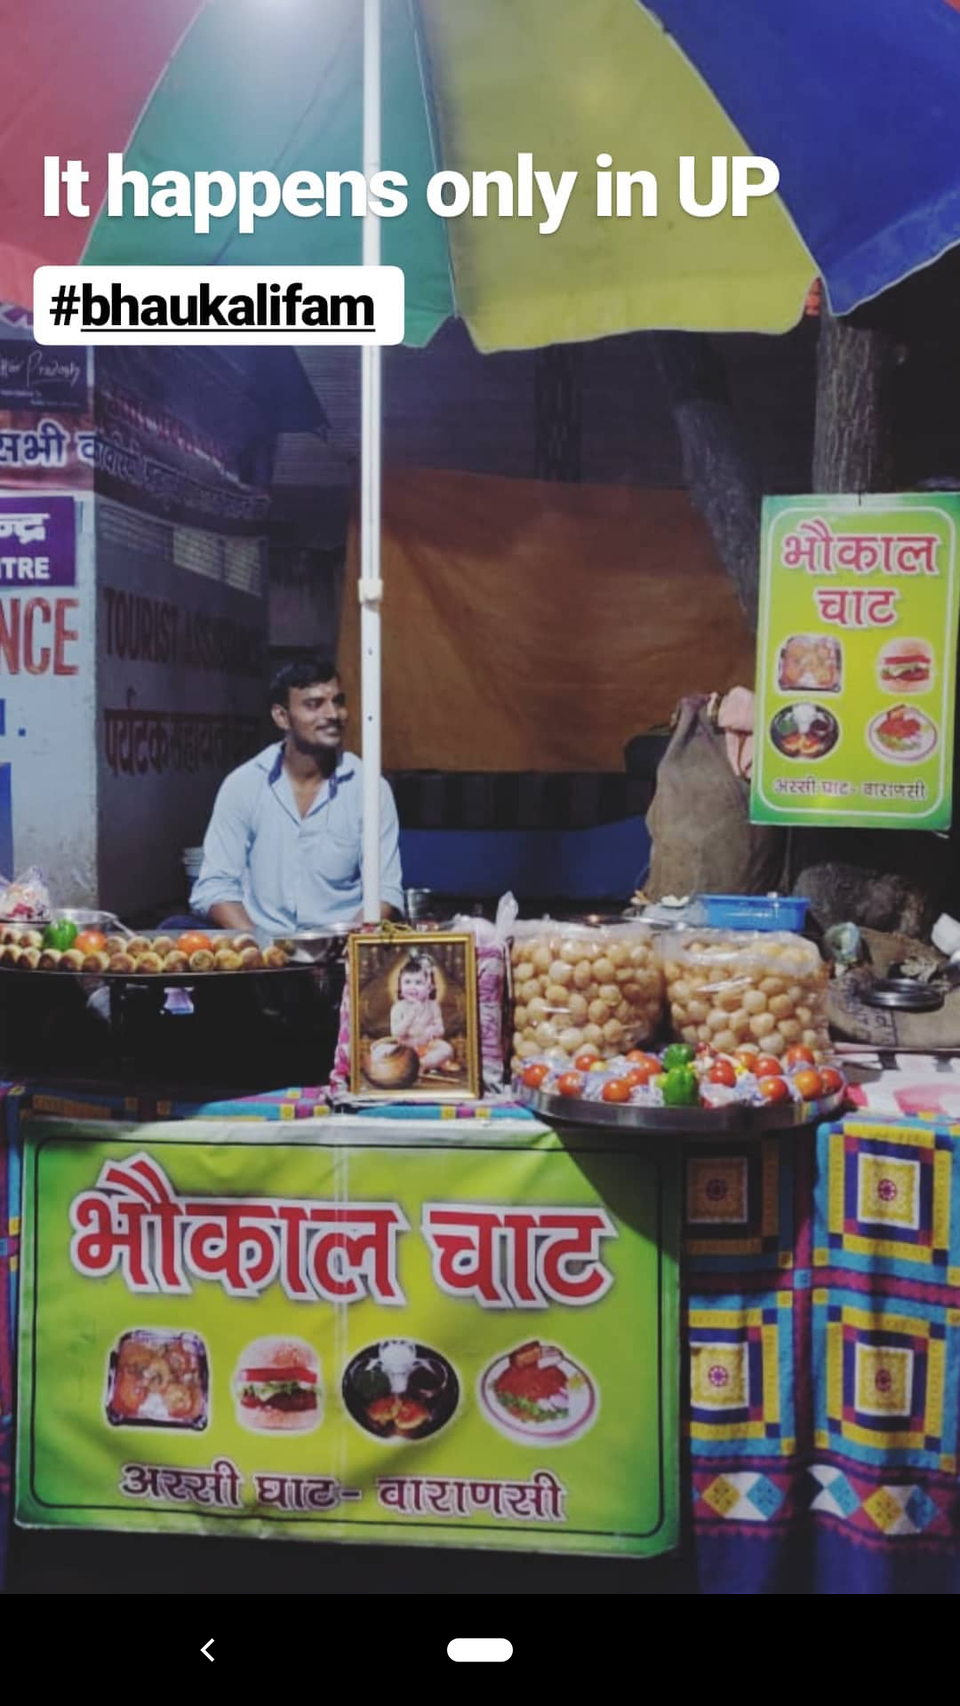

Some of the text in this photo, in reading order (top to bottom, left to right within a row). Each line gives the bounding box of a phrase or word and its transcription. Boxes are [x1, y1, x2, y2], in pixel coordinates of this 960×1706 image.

[0, 420, 66, 466] सभी
[0, 556, 51, 579] TRE
[783, 518, 938, 573] भौकाल
[103, 587, 181, 667] TOURIST
[817, 589, 896, 625] चाट
[862, 779, 925, 798] वाराणसी
[73, 1156, 613, 1304] भौकाल चाट
[121, 1458, 241, 1506] अस्सी
[377, 1471, 566, 1519] वाराणसी
